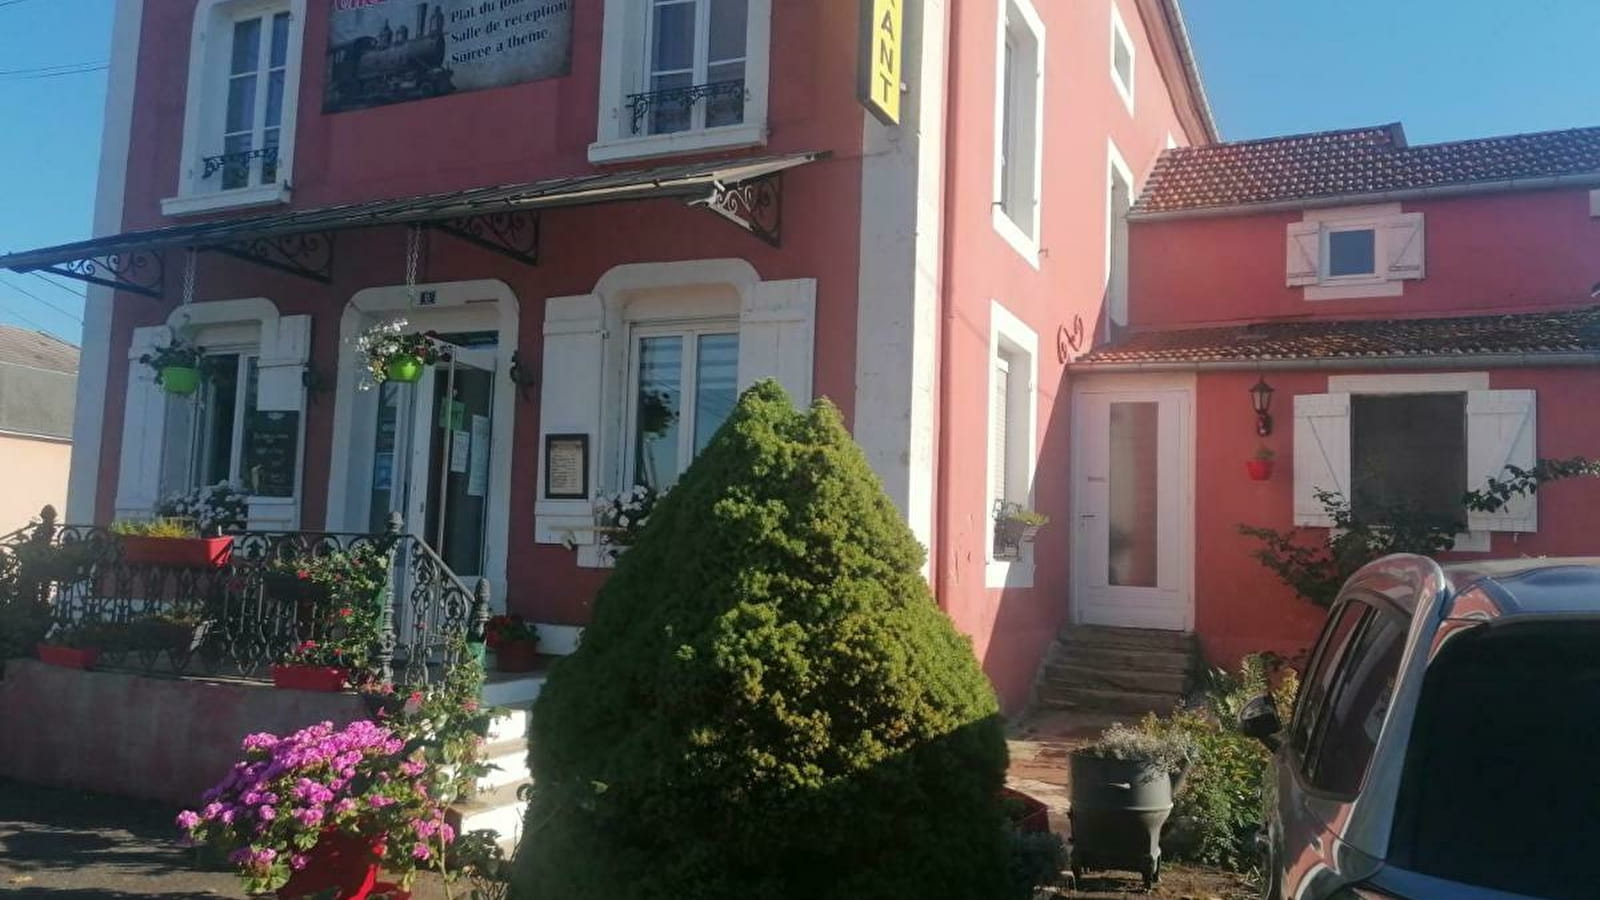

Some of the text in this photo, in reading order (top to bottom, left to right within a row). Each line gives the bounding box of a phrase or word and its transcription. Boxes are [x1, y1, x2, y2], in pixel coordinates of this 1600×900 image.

[451, 6, 475, 23] Plat
[479, 1, 495, 15] du
[451, 25, 480, 43] Salle
[486, 20, 500, 34] de
[879, 0, 895, 103] ANT
